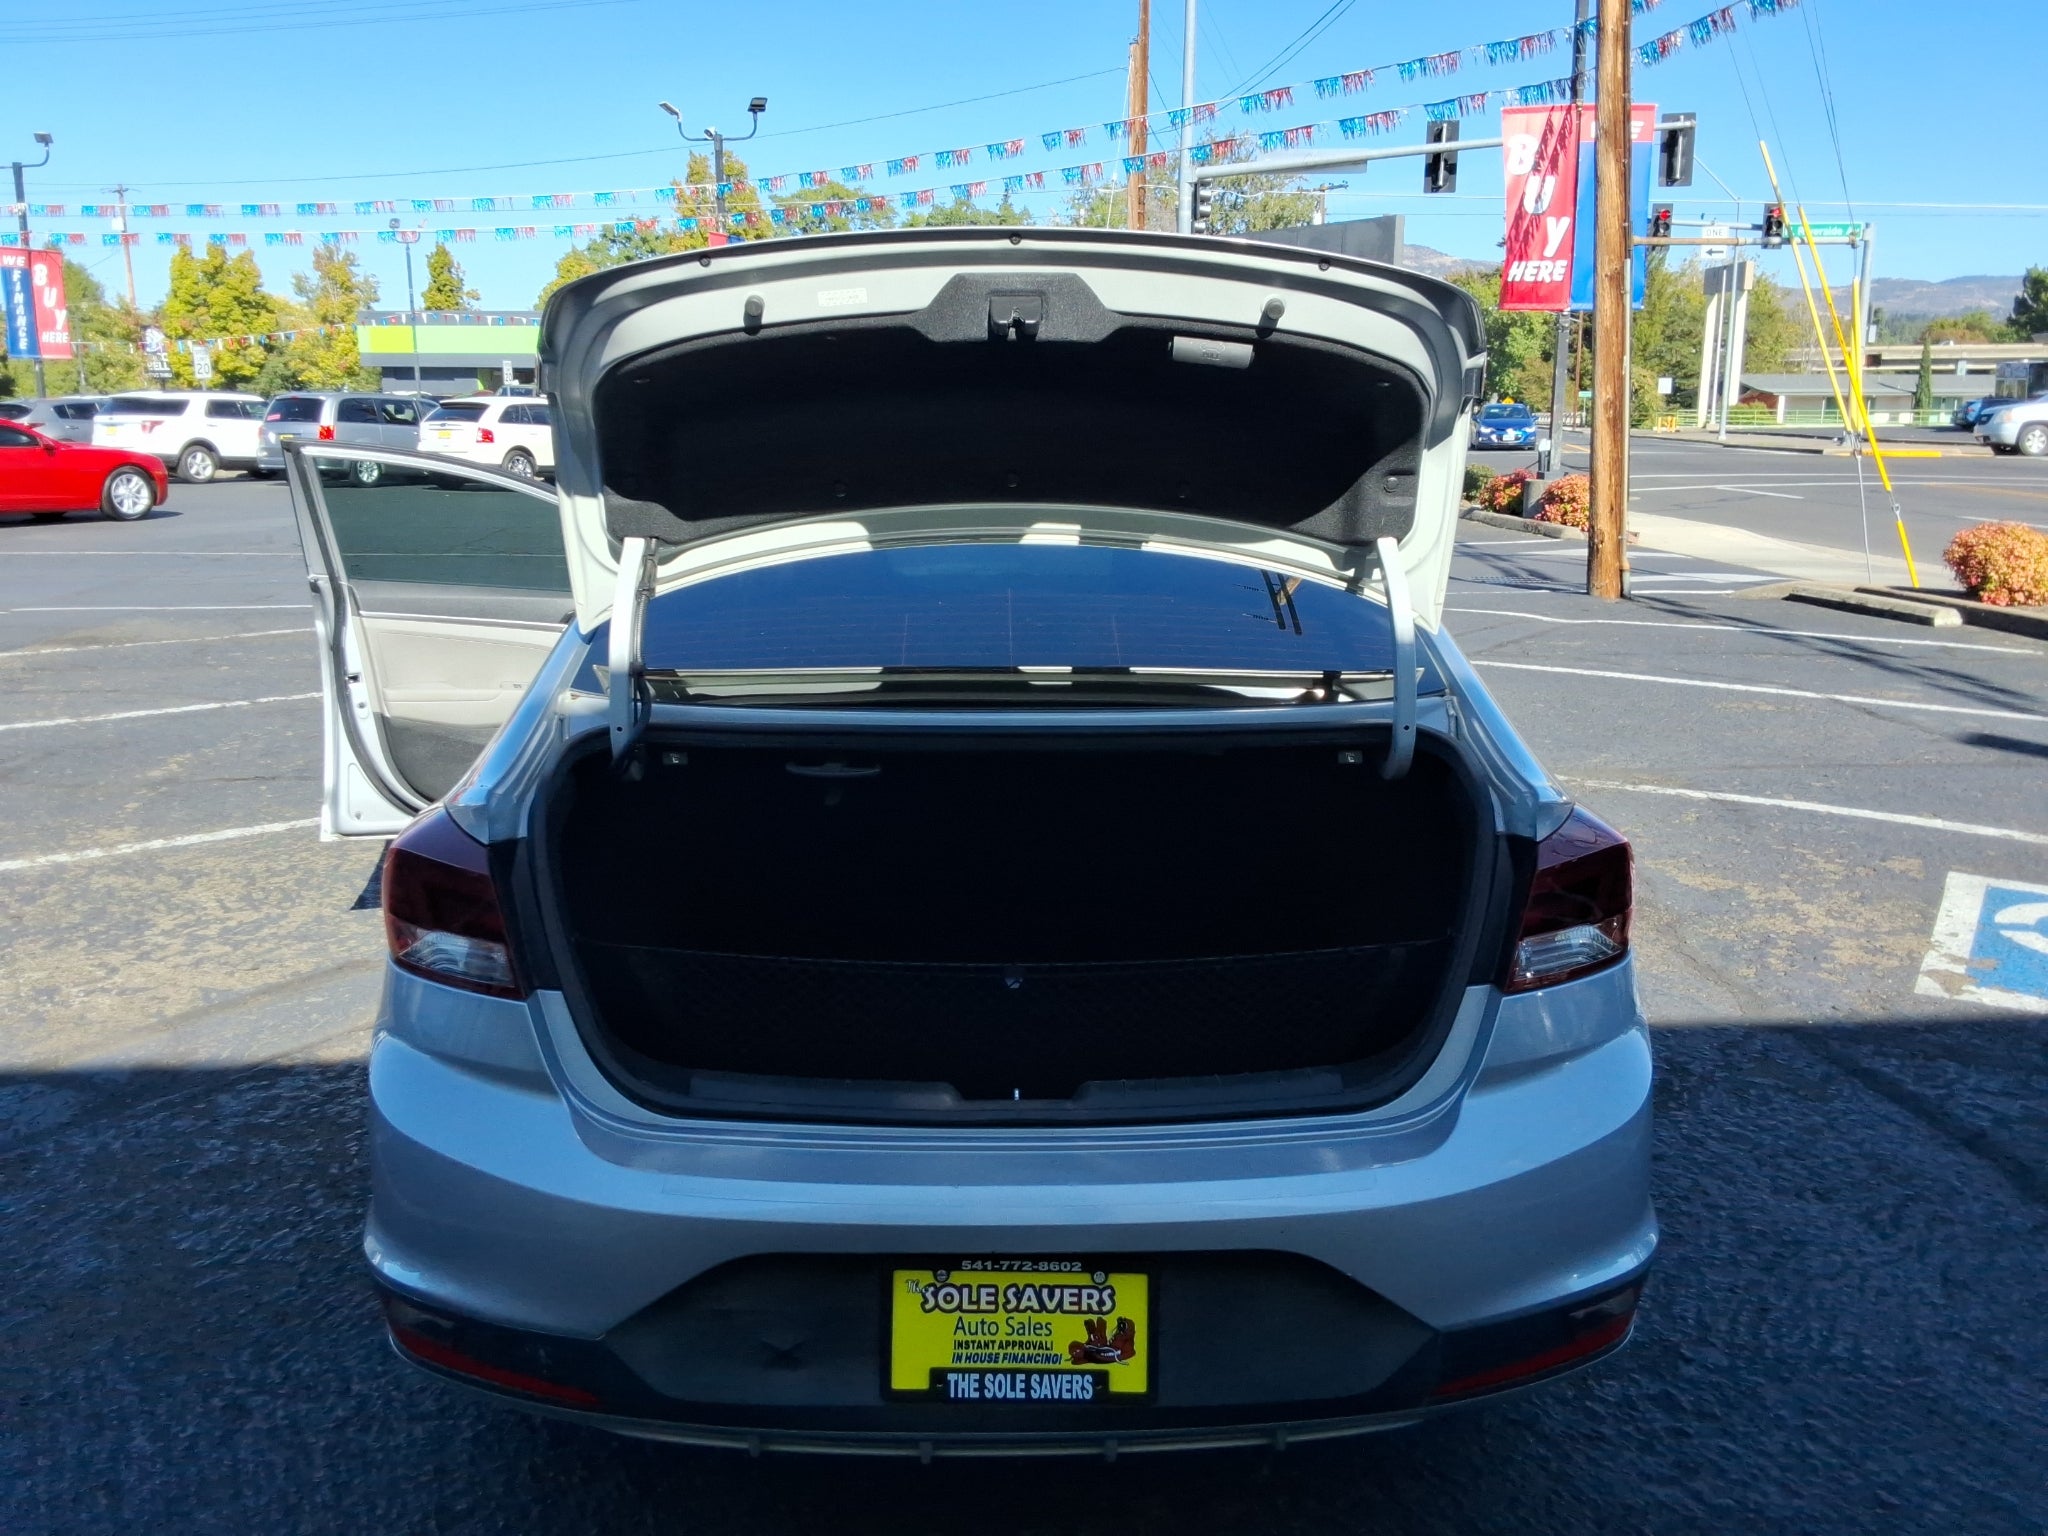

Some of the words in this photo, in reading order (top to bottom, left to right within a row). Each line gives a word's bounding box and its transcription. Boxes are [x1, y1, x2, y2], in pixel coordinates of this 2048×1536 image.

[1506, 134, 1571, 257] BUY
[1706, 228, 1724, 237] ONE
[1797, 226, 1843, 236] Rerside
[2, 255, 26, 266] WE
[1507, 259, 1569, 283] HERE
[33, 263, 67, 331] BUY
[42, 331, 69, 343] HERE
[197, 363, 210, 375] 20
[504, 372, 513, 382] 20
[961, 1260, 1082, 1272] 541-772-8602
[921, 1283, 999, 1313] SOLE
[1004, 1283, 1115, 1315] SAVERS
[953, 1316, 999, 1336] Auto
[1005, 1316, 1053, 1337] Sales
[953, 1340, 996, 1350] INSTANT
[998, 1340, 1053, 1351] APPROVAL!
[951, 1352, 963, 1364] IN
[964, 1353, 999, 1364] HOUSE
[1001, 1353, 1063, 1365] FINANCING!
[947, 1373, 979, 1398] THE
[984, 1373, 1026, 1399] SOLE
[1030, 1373, 1093, 1400] SAVERS
